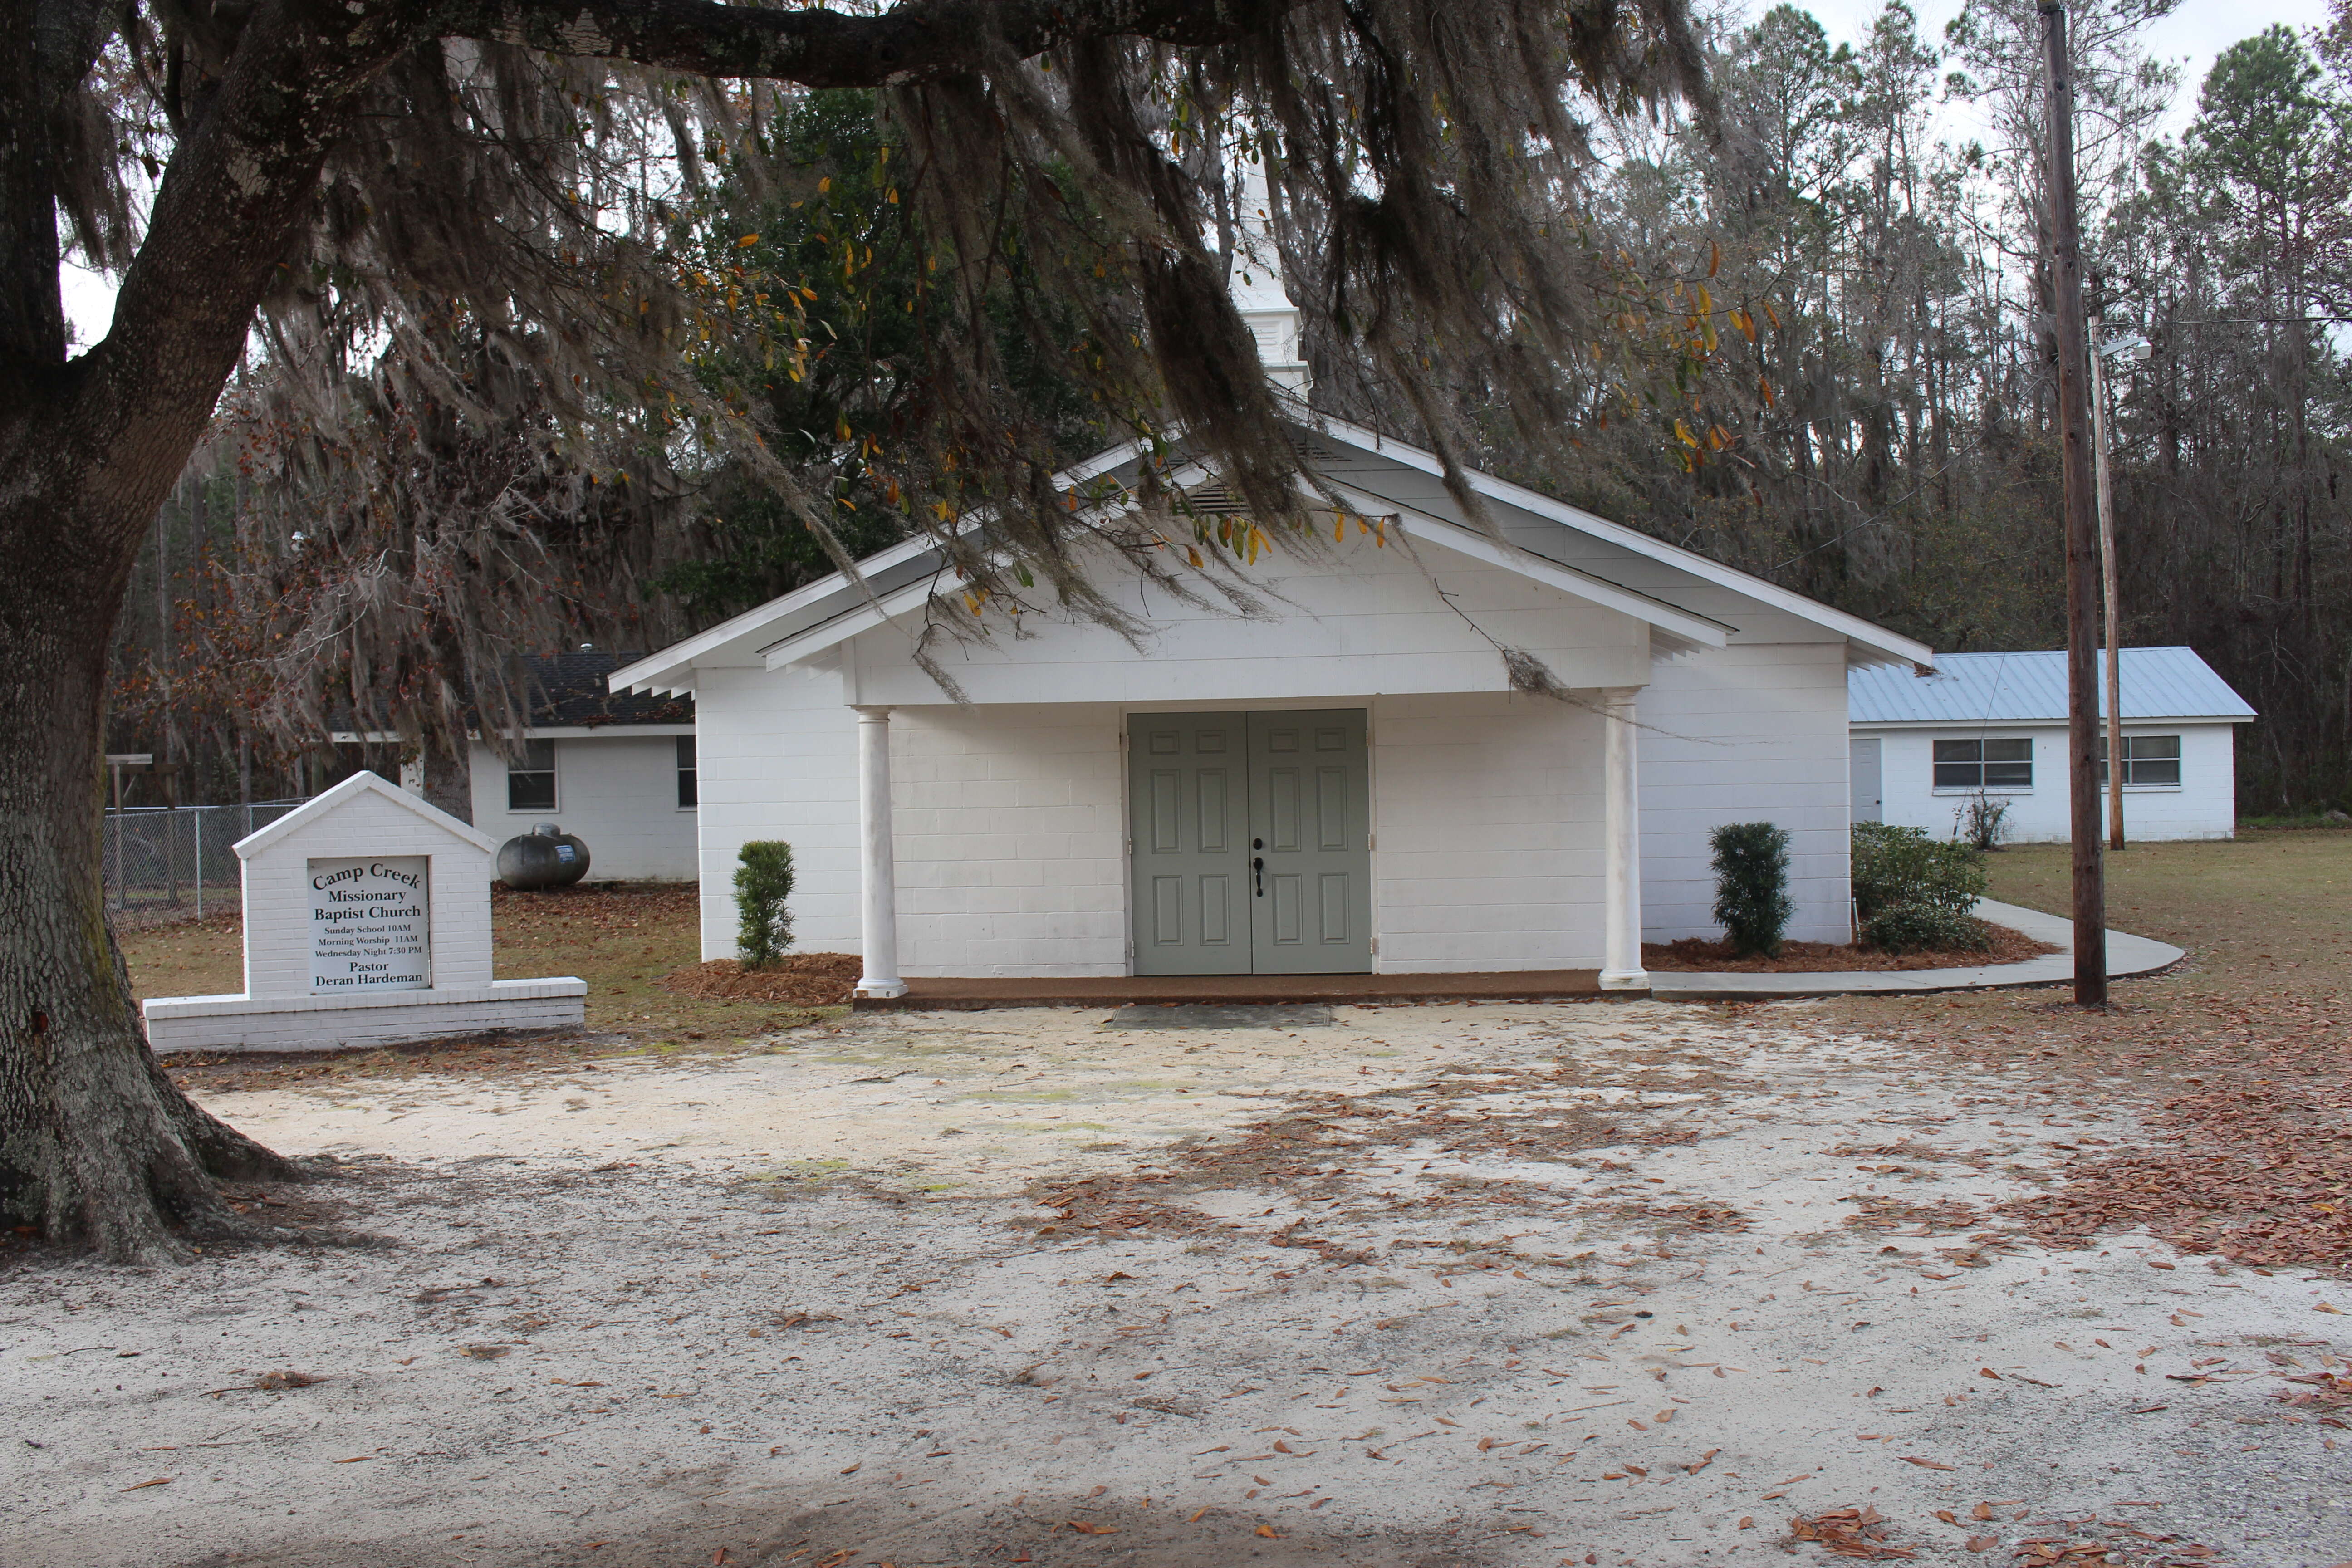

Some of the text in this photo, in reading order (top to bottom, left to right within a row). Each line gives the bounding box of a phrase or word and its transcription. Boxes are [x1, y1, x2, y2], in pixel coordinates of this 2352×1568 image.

[313, 863, 420, 890] Camp Creek
[329, 890, 407, 904] Missionary
[315, 906, 421, 923] Baptist Church
[325, 927, 355, 935] Sunday
[357, 925, 385, 933] School
[318, 937, 354, 946] Morning
[356, 936, 390, 945] Worship
[315, 950, 361, 958] Wednesday
[363, 948, 386, 957] Night
[349, 962, 389, 972] Pastor
[315, 973, 422, 986] Deran Hardeman
